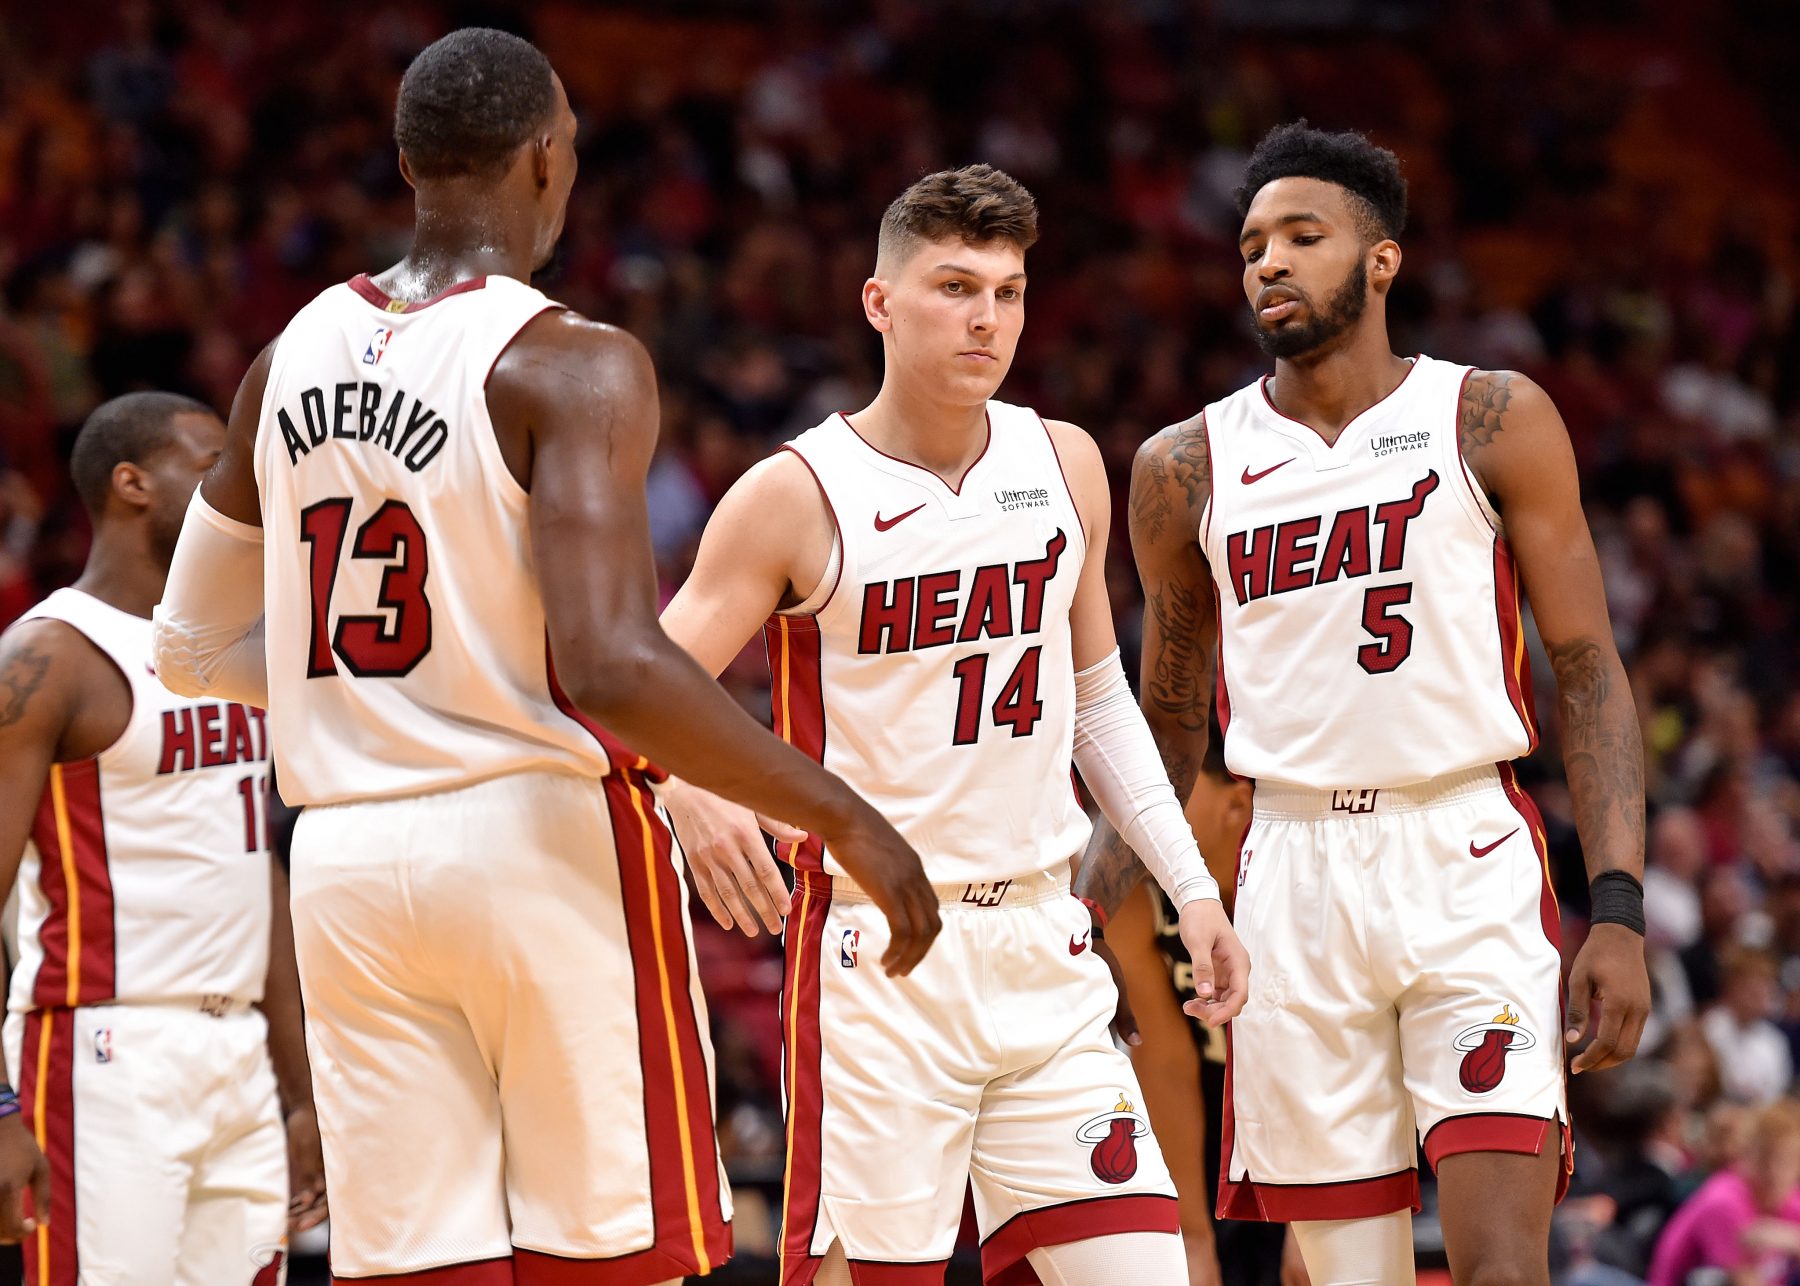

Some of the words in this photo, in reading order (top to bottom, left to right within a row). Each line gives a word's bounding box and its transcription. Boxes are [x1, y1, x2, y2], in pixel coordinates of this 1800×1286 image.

[278, 380, 449, 473] ADEBAYO
[1370, 431, 1430, 450] Ultimate
[1374, 441, 1429, 458] SOFTWARE
[994, 488, 1048, 504] Ultimate
[1002, 499, 1050, 512] SOFTWARE
[1226, 469, 1440, 607] HEAT
[301, 497, 432, 679] 13
[857, 527, 1067, 655] HEAT
[1357, 582, 1413, 675] 5
[156, 702, 267, 775] HEAT
[952, 645, 1043, 746] 14
